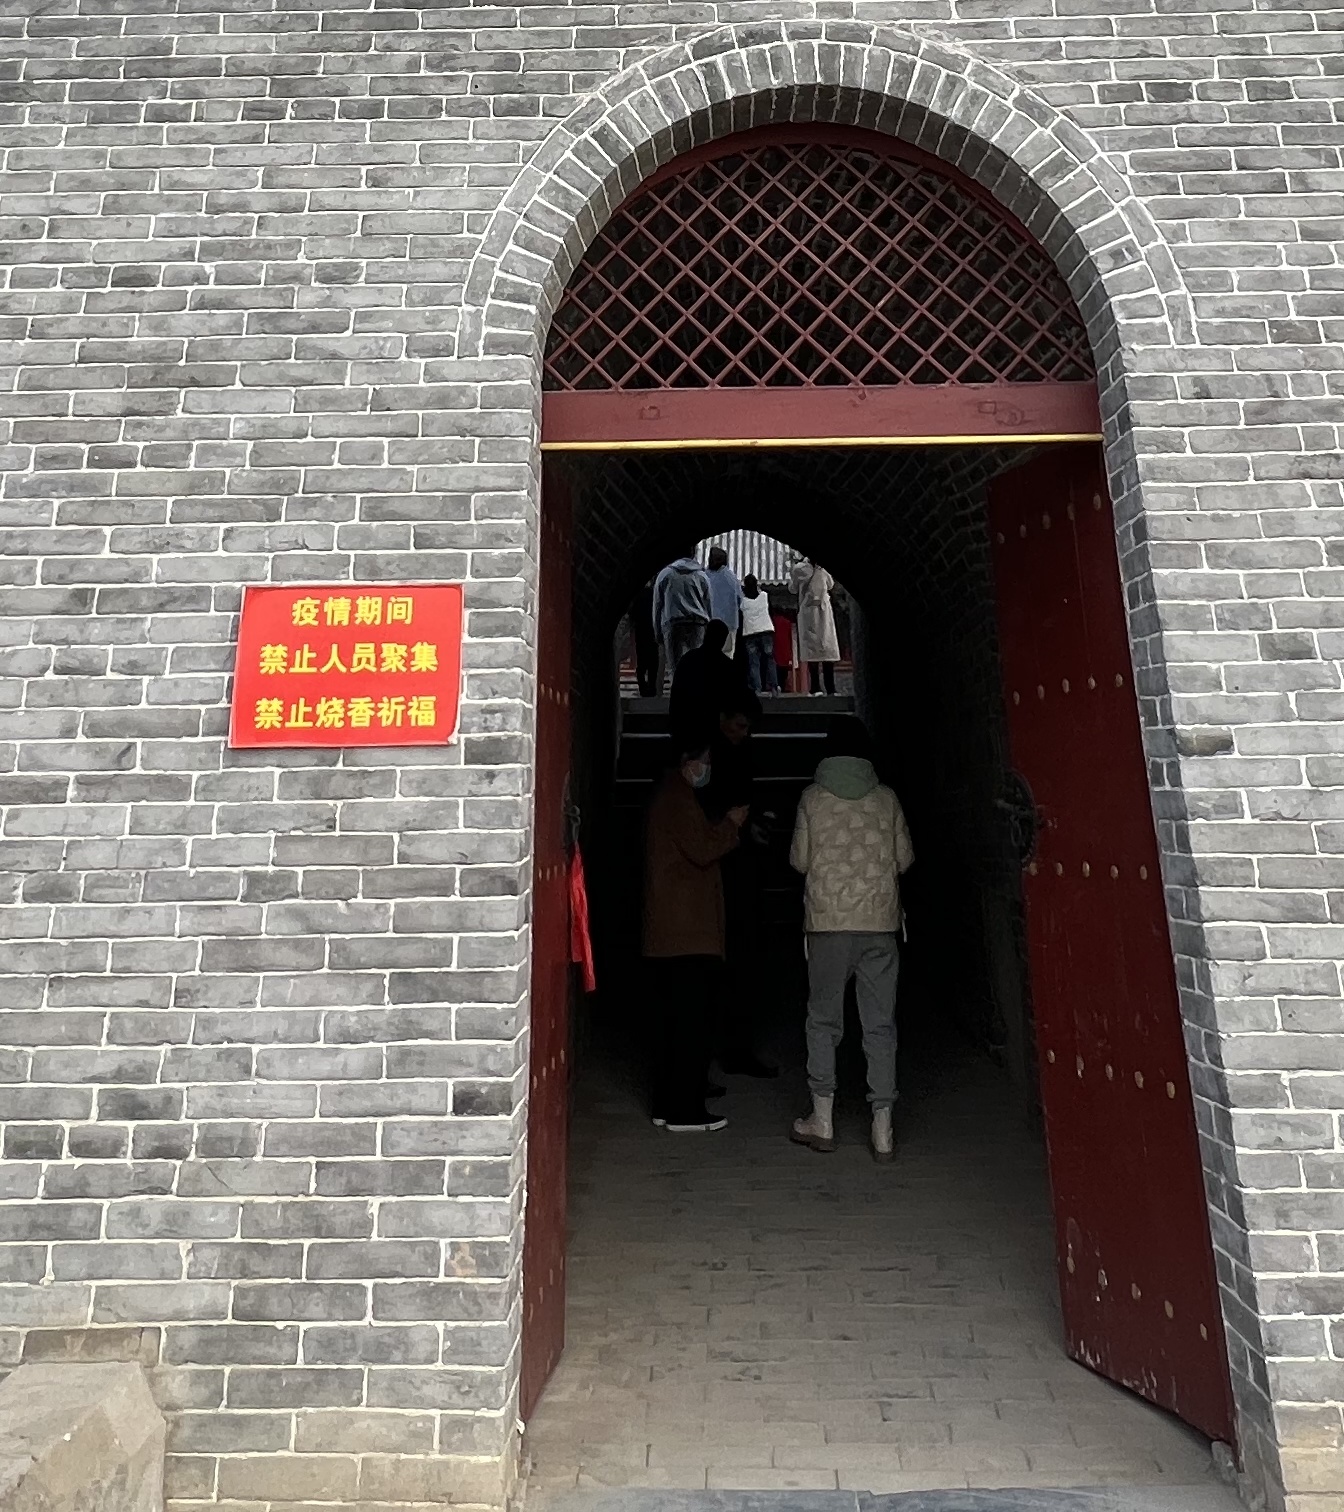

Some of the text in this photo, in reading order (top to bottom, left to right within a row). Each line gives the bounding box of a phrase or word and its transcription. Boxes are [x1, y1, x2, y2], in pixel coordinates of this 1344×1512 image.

[291, 595, 414, 626] 疫情期间
[259, 641, 439, 674] 禁止人员聚集
[253, 695, 437, 729] 禁止烧香祈福
